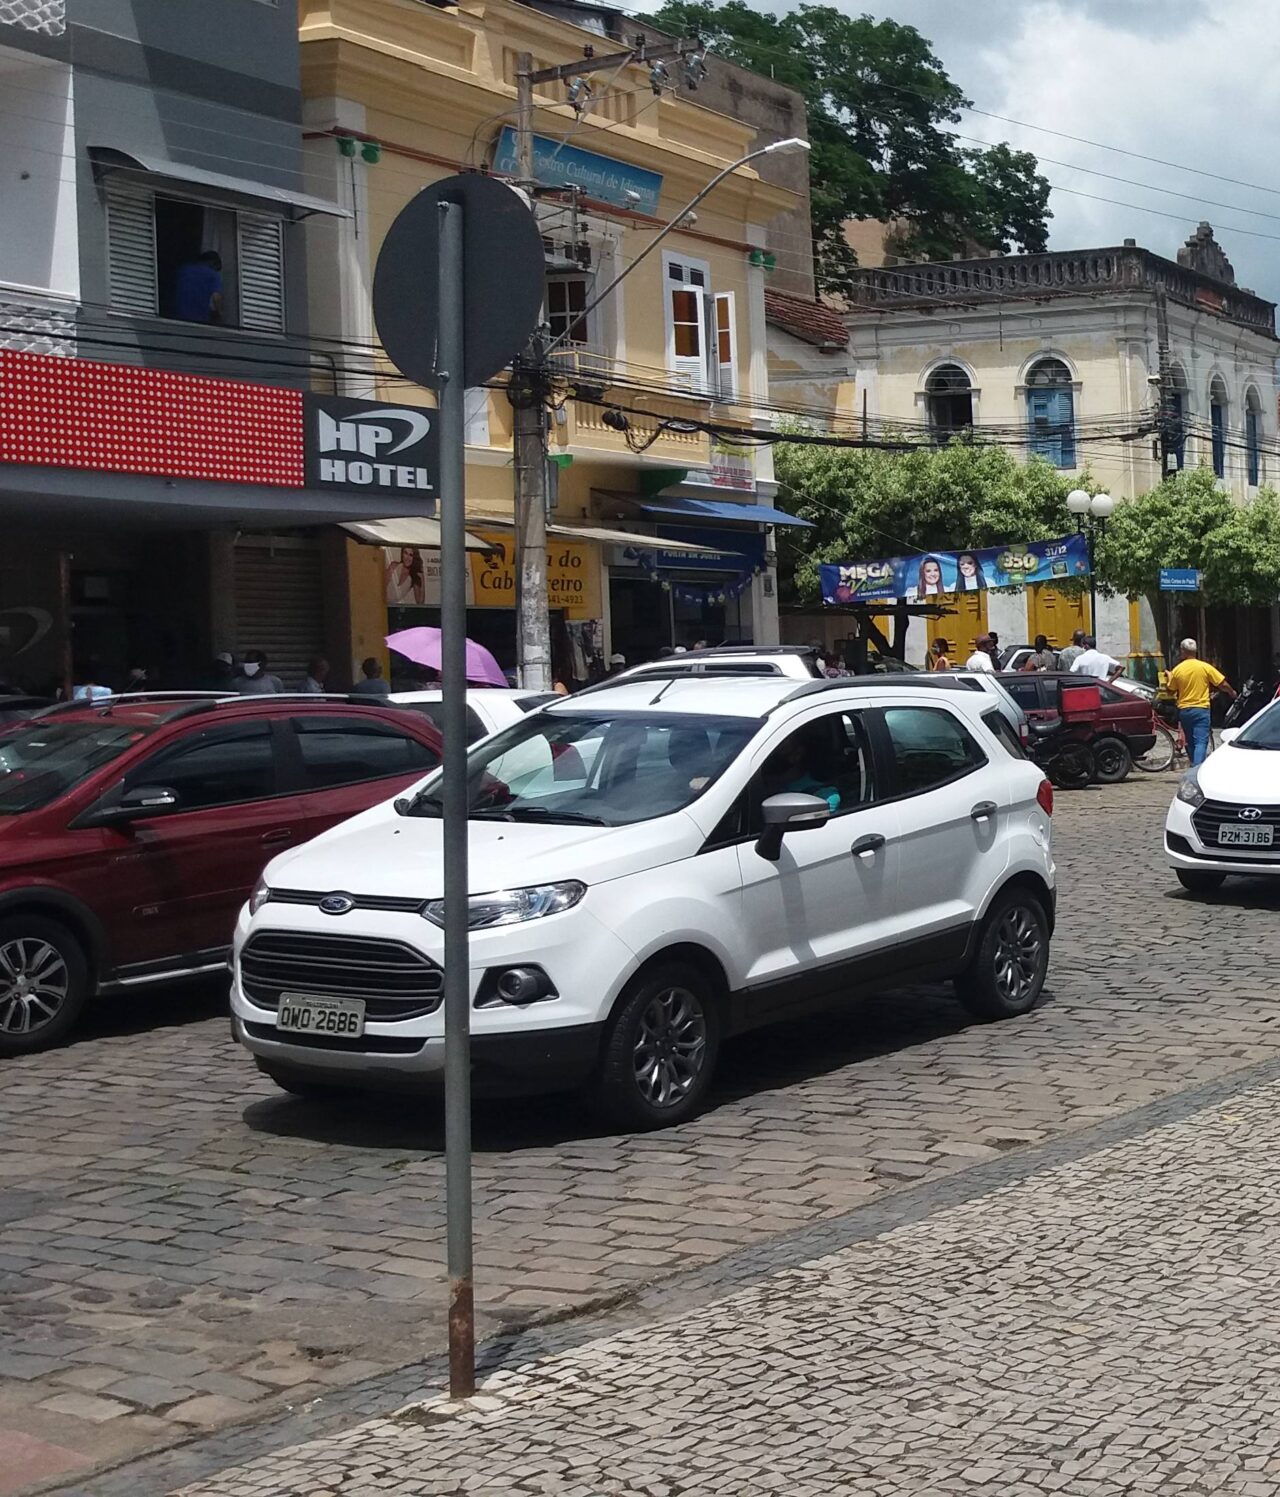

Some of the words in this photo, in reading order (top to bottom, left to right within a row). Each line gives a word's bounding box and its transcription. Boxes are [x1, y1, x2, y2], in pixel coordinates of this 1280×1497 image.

[566, 161, 604, 184] Cultural
[606, 174, 619, 188] de
[320, 458, 434, 490] HOTEL
[558, 550, 582, 569] do
[1003, 551, 1035, 569] 350
[1044, 544, 1068, 557] 31/12
[839, 562, 895, 580] MEGA
[480, 569, 583, 593] Cabeiro
